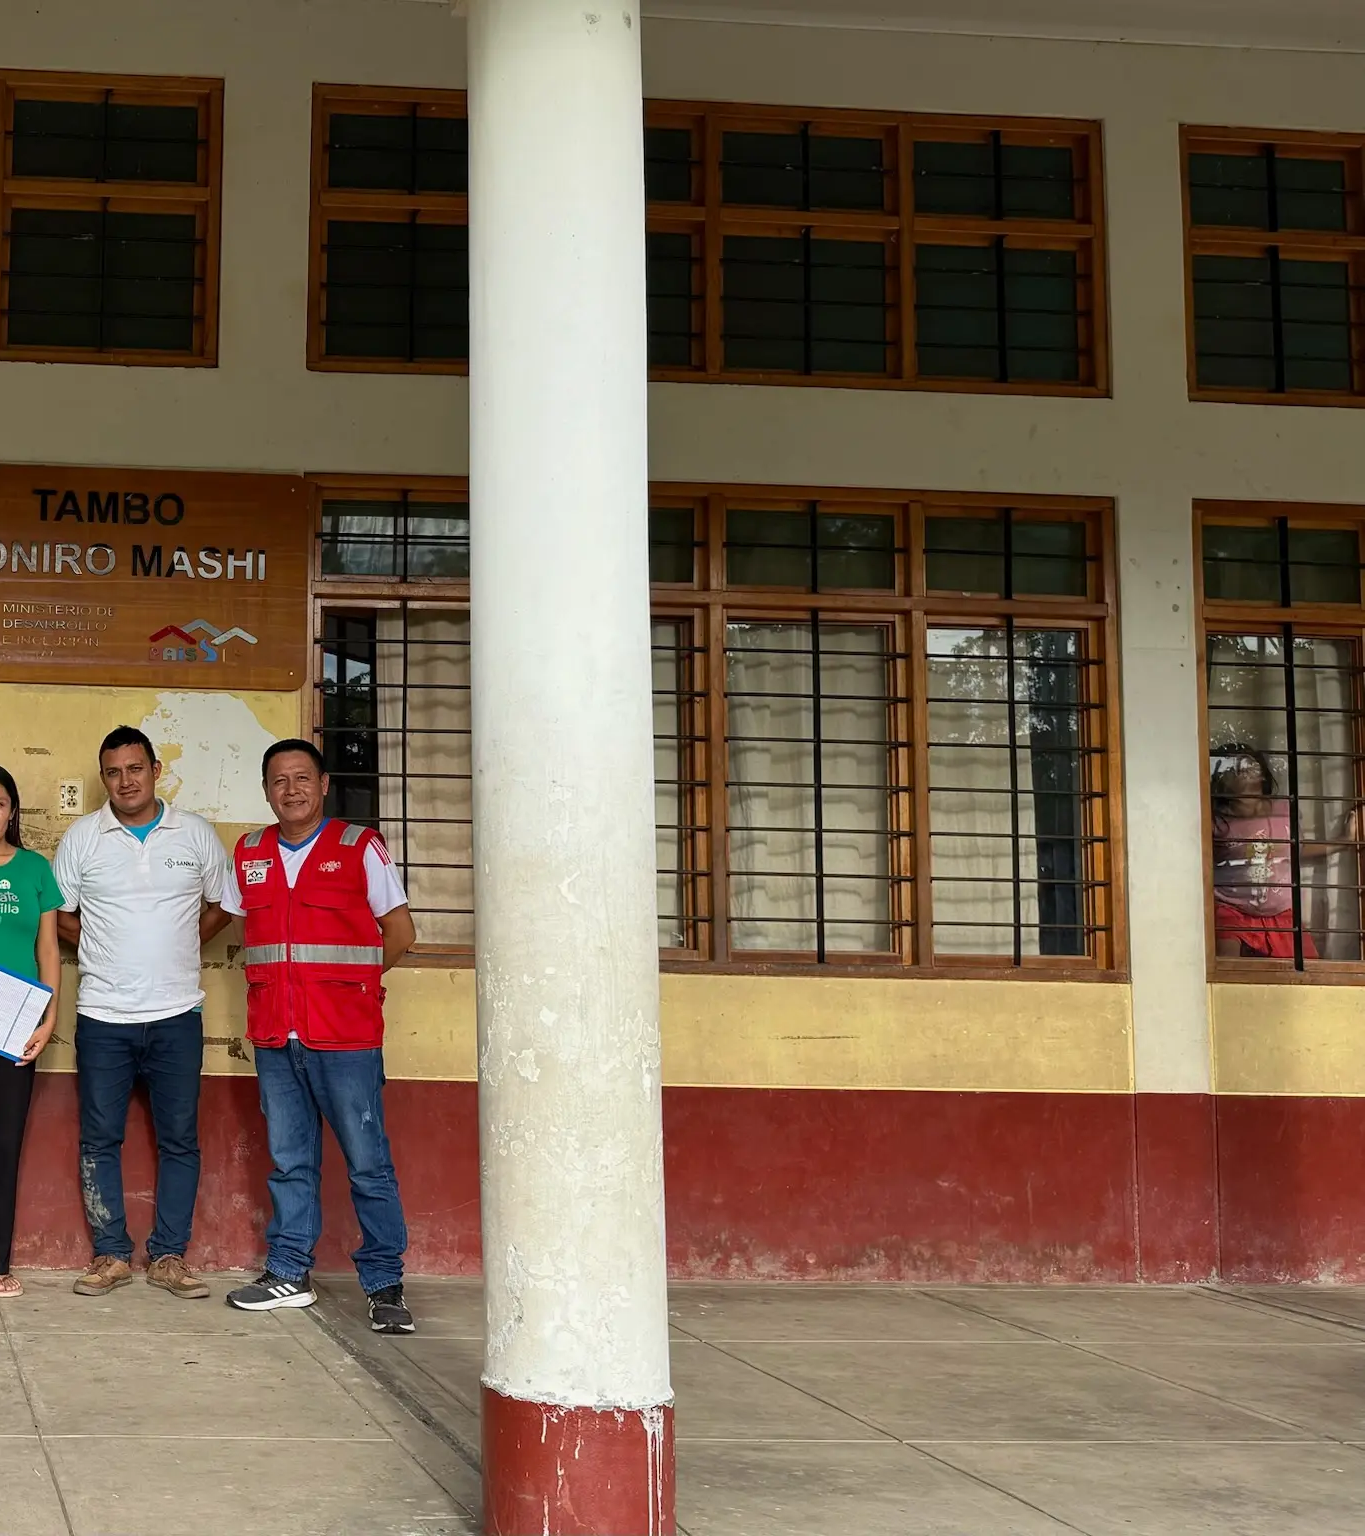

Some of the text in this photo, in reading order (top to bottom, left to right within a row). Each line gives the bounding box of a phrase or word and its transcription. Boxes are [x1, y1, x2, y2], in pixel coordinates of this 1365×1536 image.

[32, 488, 184, 526] TAMBO
[131, 543, 267, 581] MASHI
[3, 603, 92, 617] MINISTERIO
[2, 618, 108, 632] DESARROLLO
